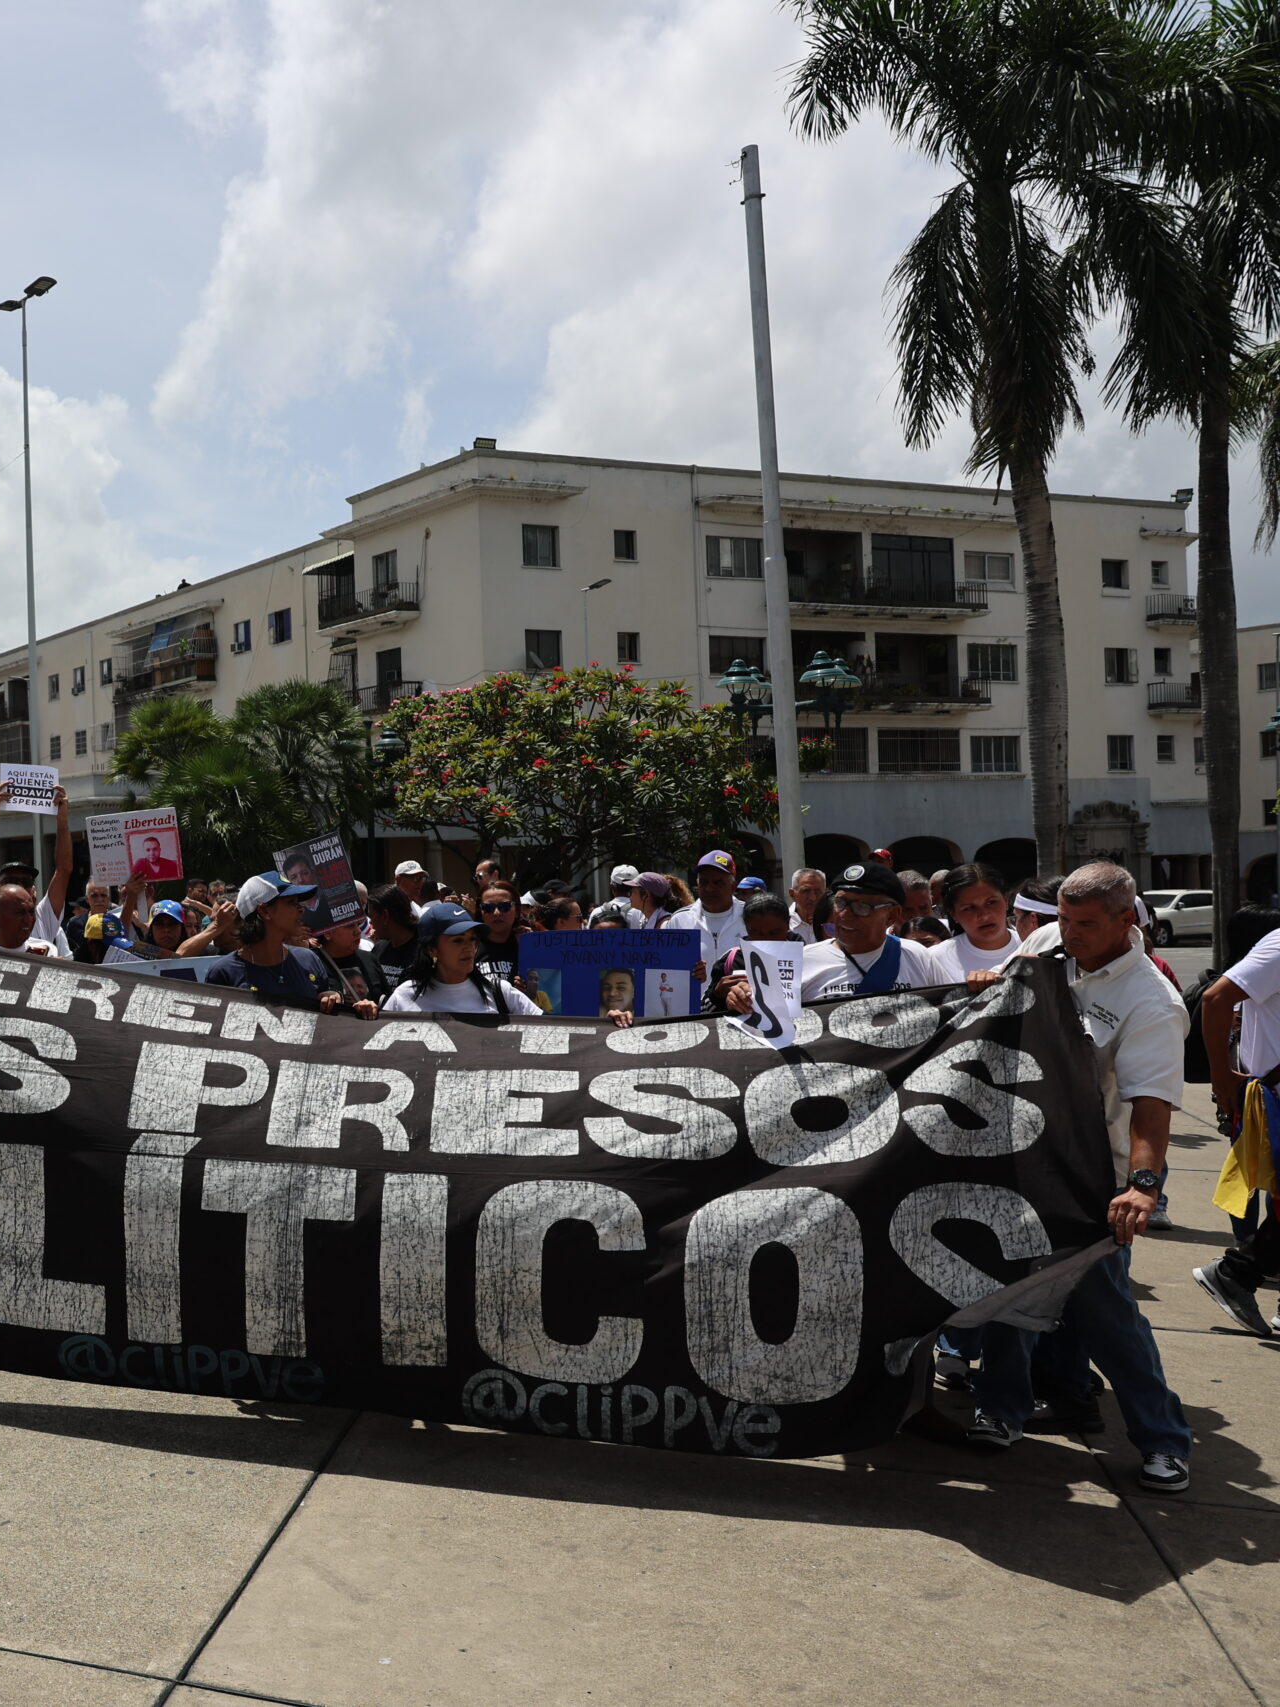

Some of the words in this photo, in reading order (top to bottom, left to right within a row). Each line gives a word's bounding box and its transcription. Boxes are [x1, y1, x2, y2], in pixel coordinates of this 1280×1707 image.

[8, 777, 54, 788] QUIENES
[30, 771, 54, 779] ESTÁN
[9, 788, 52, 797] TODAVÍA
[7, 798, 51, 807] ESPERAN
[124, 814, 176, 829] Libertad!
[309, 836, 340, 853] FRANKLIN
[312, 846, 343, 865] DURÁN
[330, 901, 360, 918] MEDIDA
[534, 931, 605, 947] JUSTICIA
[606, 932, 616, 946] Y
[617, 931, 691, 947] LIBERTAD
[780, 969, 793, 979] ÓN
[363, 1021, 458, 1053] A
[126, 1039, 1045, 1167] PRESOS
